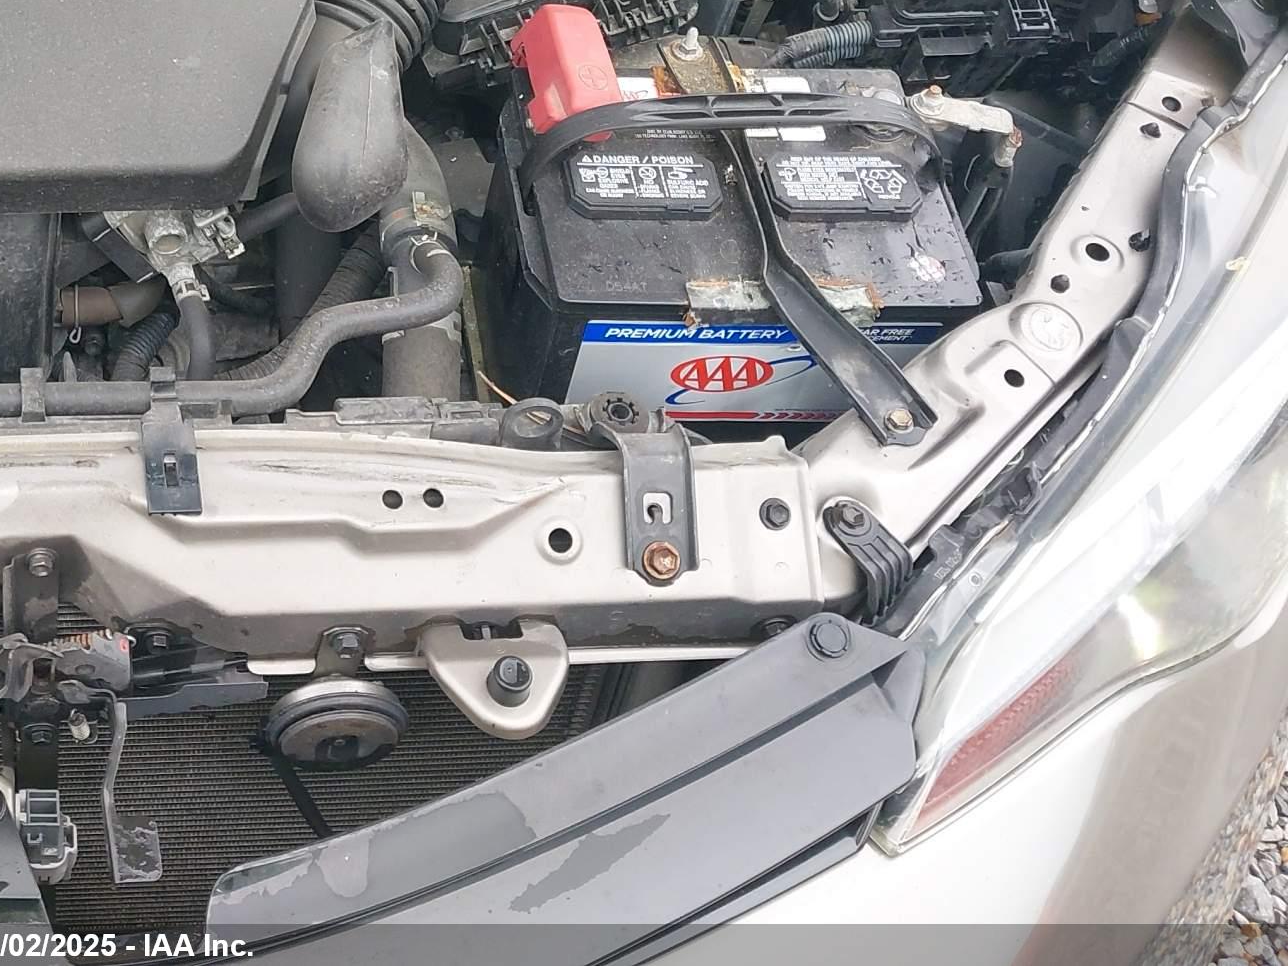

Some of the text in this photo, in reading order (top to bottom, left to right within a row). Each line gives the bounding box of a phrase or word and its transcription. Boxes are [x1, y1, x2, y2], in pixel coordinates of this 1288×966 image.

[593, 155, 640, 164] DANGER
[651, 156, 694, 165] POISON
[605, 328, 788, 340] PREMIUM BATTERY
[881, 328, 916, 336] FREE
[679, 356, 765, 391] AAA
